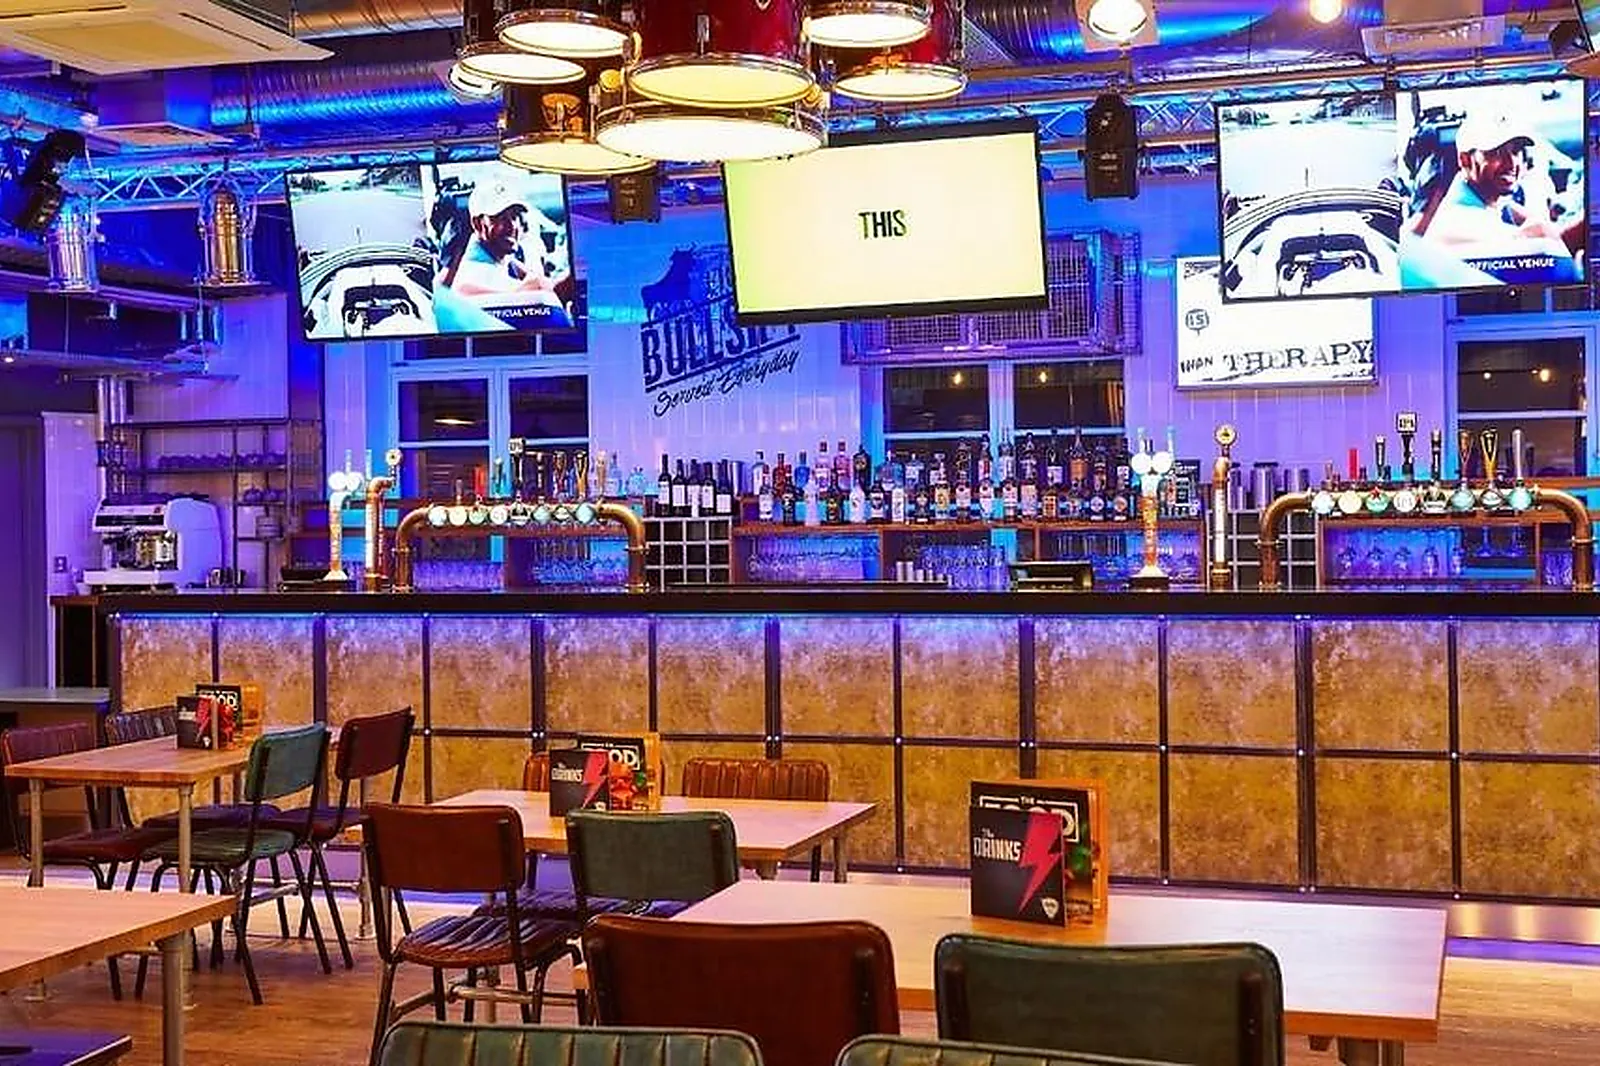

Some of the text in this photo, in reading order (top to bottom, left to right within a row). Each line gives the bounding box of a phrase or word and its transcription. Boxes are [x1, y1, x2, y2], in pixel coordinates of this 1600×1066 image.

[858, 209, 907, 240] THIS
[1518, 258, 1555, 268] VENUE
[489, 309, 523, 318] FFICIAL
[1189, 314, 1205, 326] IS
[641, 305, 797, 387] BULLS
[1222, 340, 1375, 372] THERAPY
[653, 349, 800, 418] Served Everyday
[609, 749, 637, 766] OD
[1020, 796, 1035, 805] THE
[973, 837, 1022, 861] DRINKS
